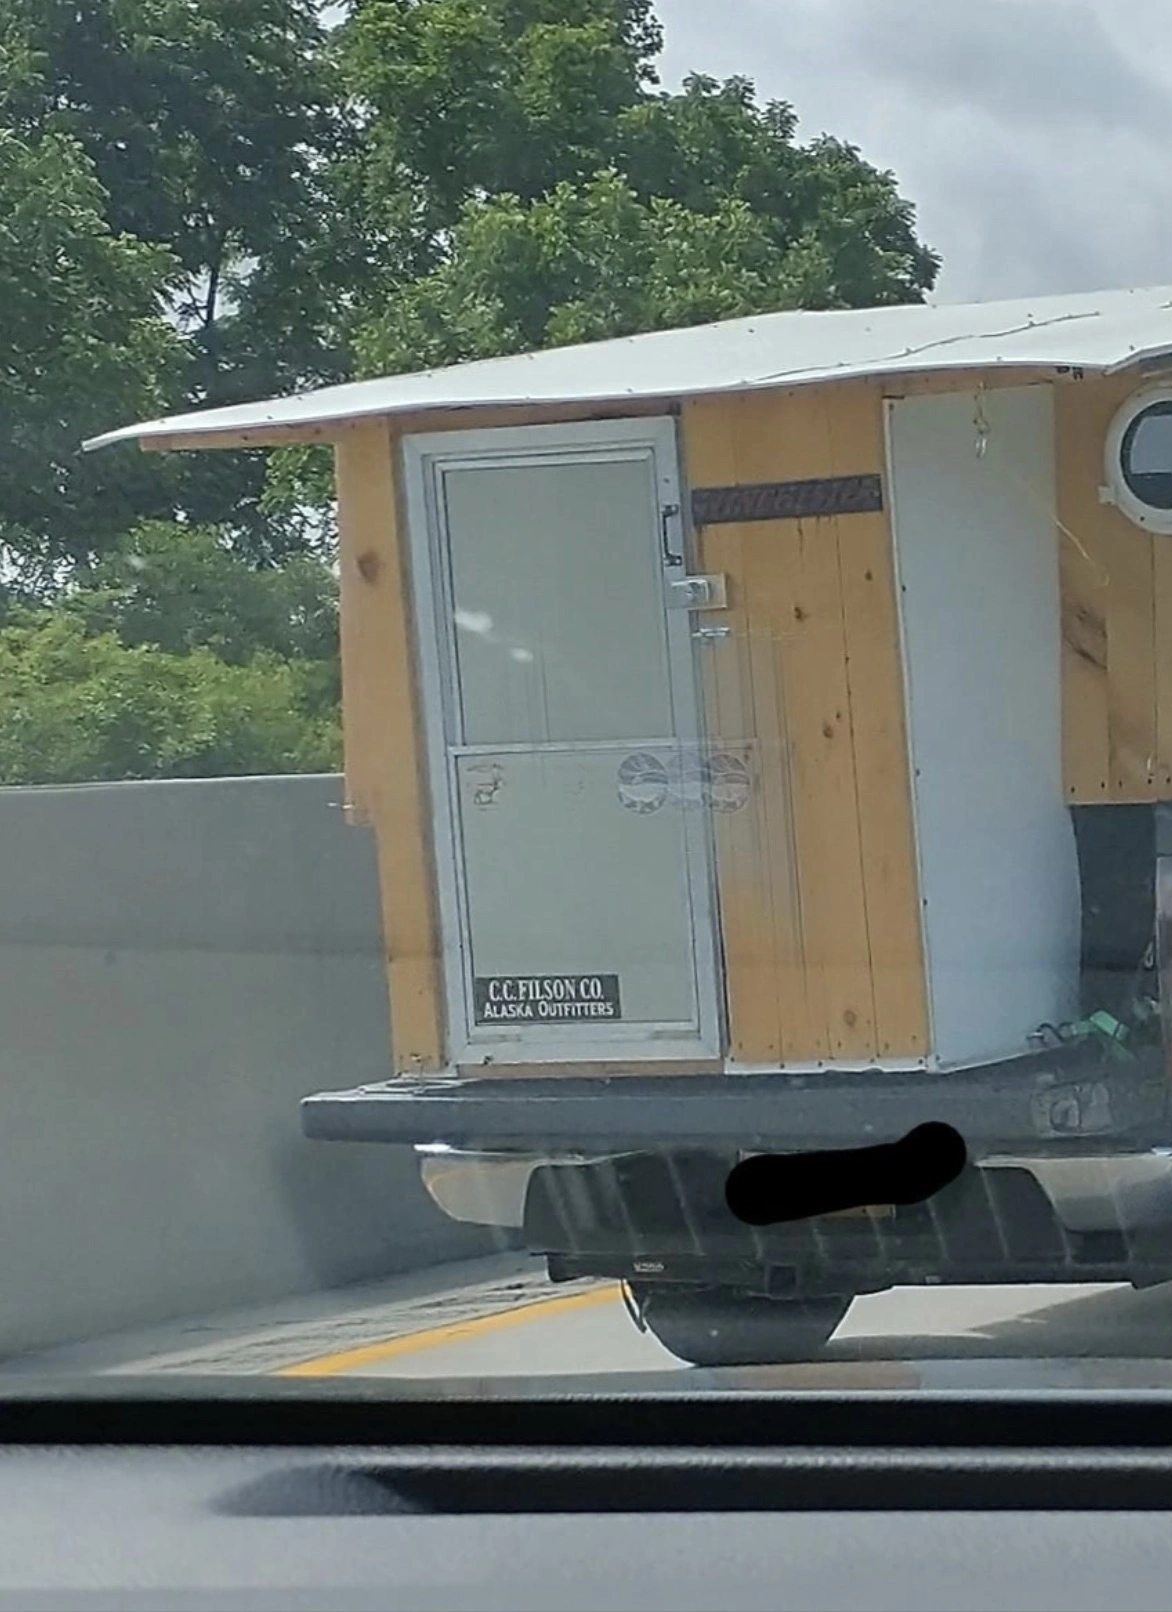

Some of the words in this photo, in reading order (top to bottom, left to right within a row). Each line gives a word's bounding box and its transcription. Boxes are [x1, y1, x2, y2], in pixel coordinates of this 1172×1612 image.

[518, 979, 576, 1001] FILSON
[580, 978, 604, 1000] CO.
[484, 1002, 533, 1018] ALASKA
[538, 1000, 614, 1017] OUTFITTERS
